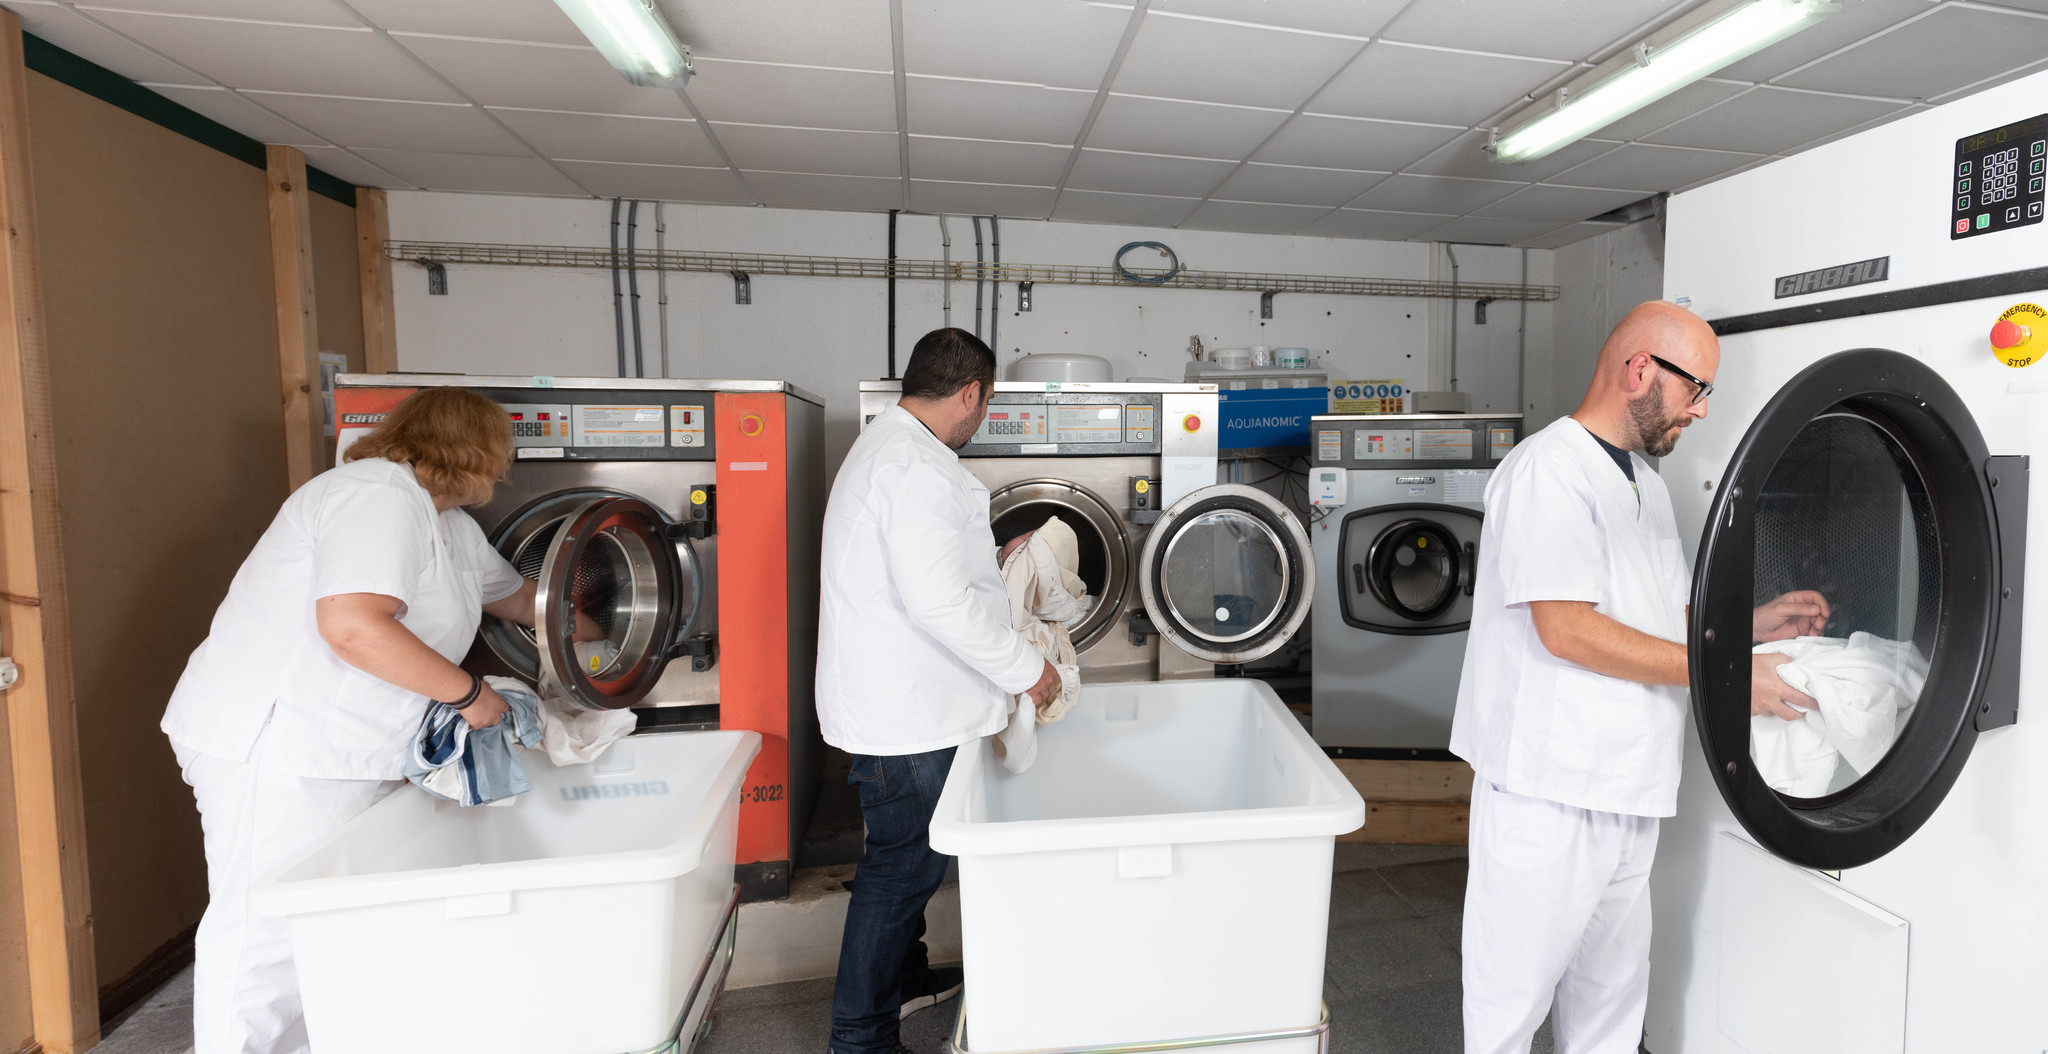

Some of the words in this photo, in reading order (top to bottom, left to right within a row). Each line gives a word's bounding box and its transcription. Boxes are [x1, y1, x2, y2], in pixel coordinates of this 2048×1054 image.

[2034, 144, 2041, 153] D
[1962, 165, 1968, 173] A
[2034, 162, 2040, 171] E
[1961, 182, 1967, 190] B
[2033, 180, 2040, 189] F
[1961, 199, 1967, 207] C
[1777, 259, 1887, 297] GIRBAU
[2007, 357, 2031, 367] STOP
[344, 414, 386, 423] GIRB
